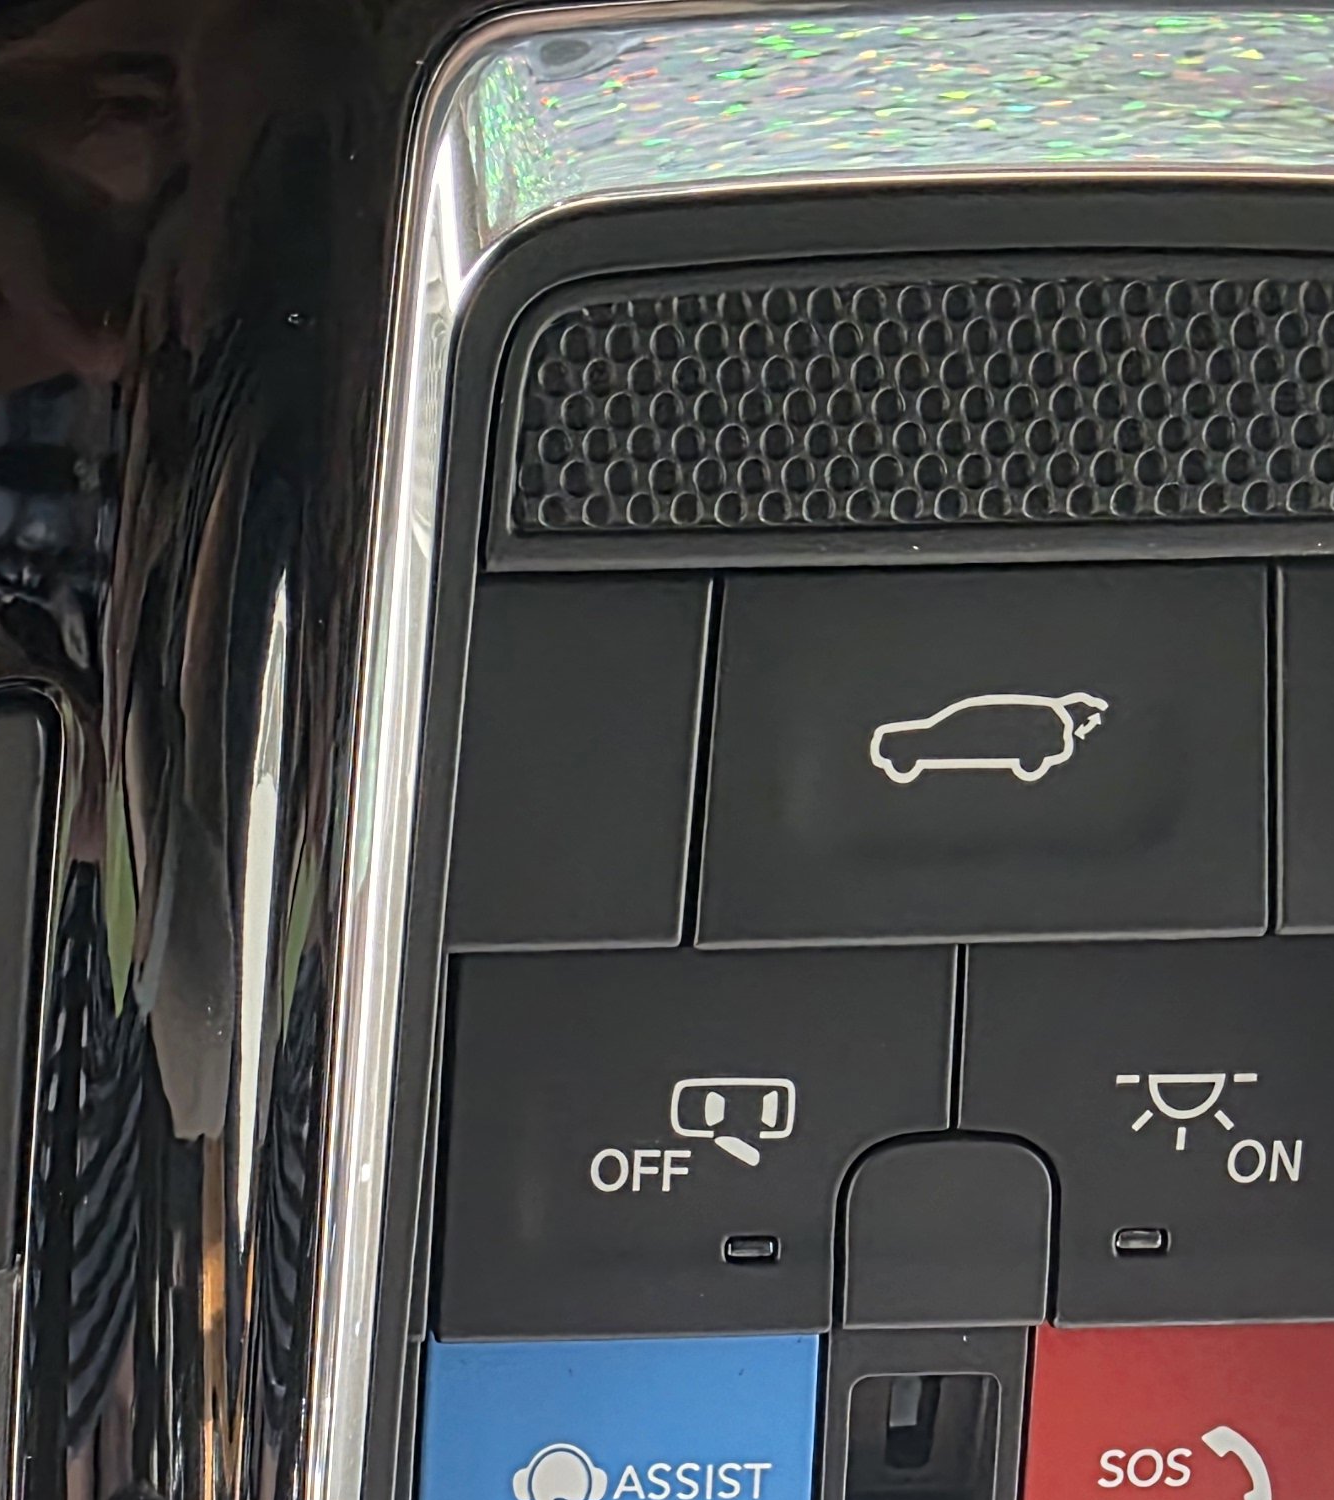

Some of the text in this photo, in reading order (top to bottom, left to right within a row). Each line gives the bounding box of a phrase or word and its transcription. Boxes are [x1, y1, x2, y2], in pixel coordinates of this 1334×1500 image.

[590, 1148, 692, 1193] OFF
[1227, 1138, 1303, 1184] ON
[612, 1462, 773, 1500] ASSIST
[1097, 1447, 1193, 1488] SOS
